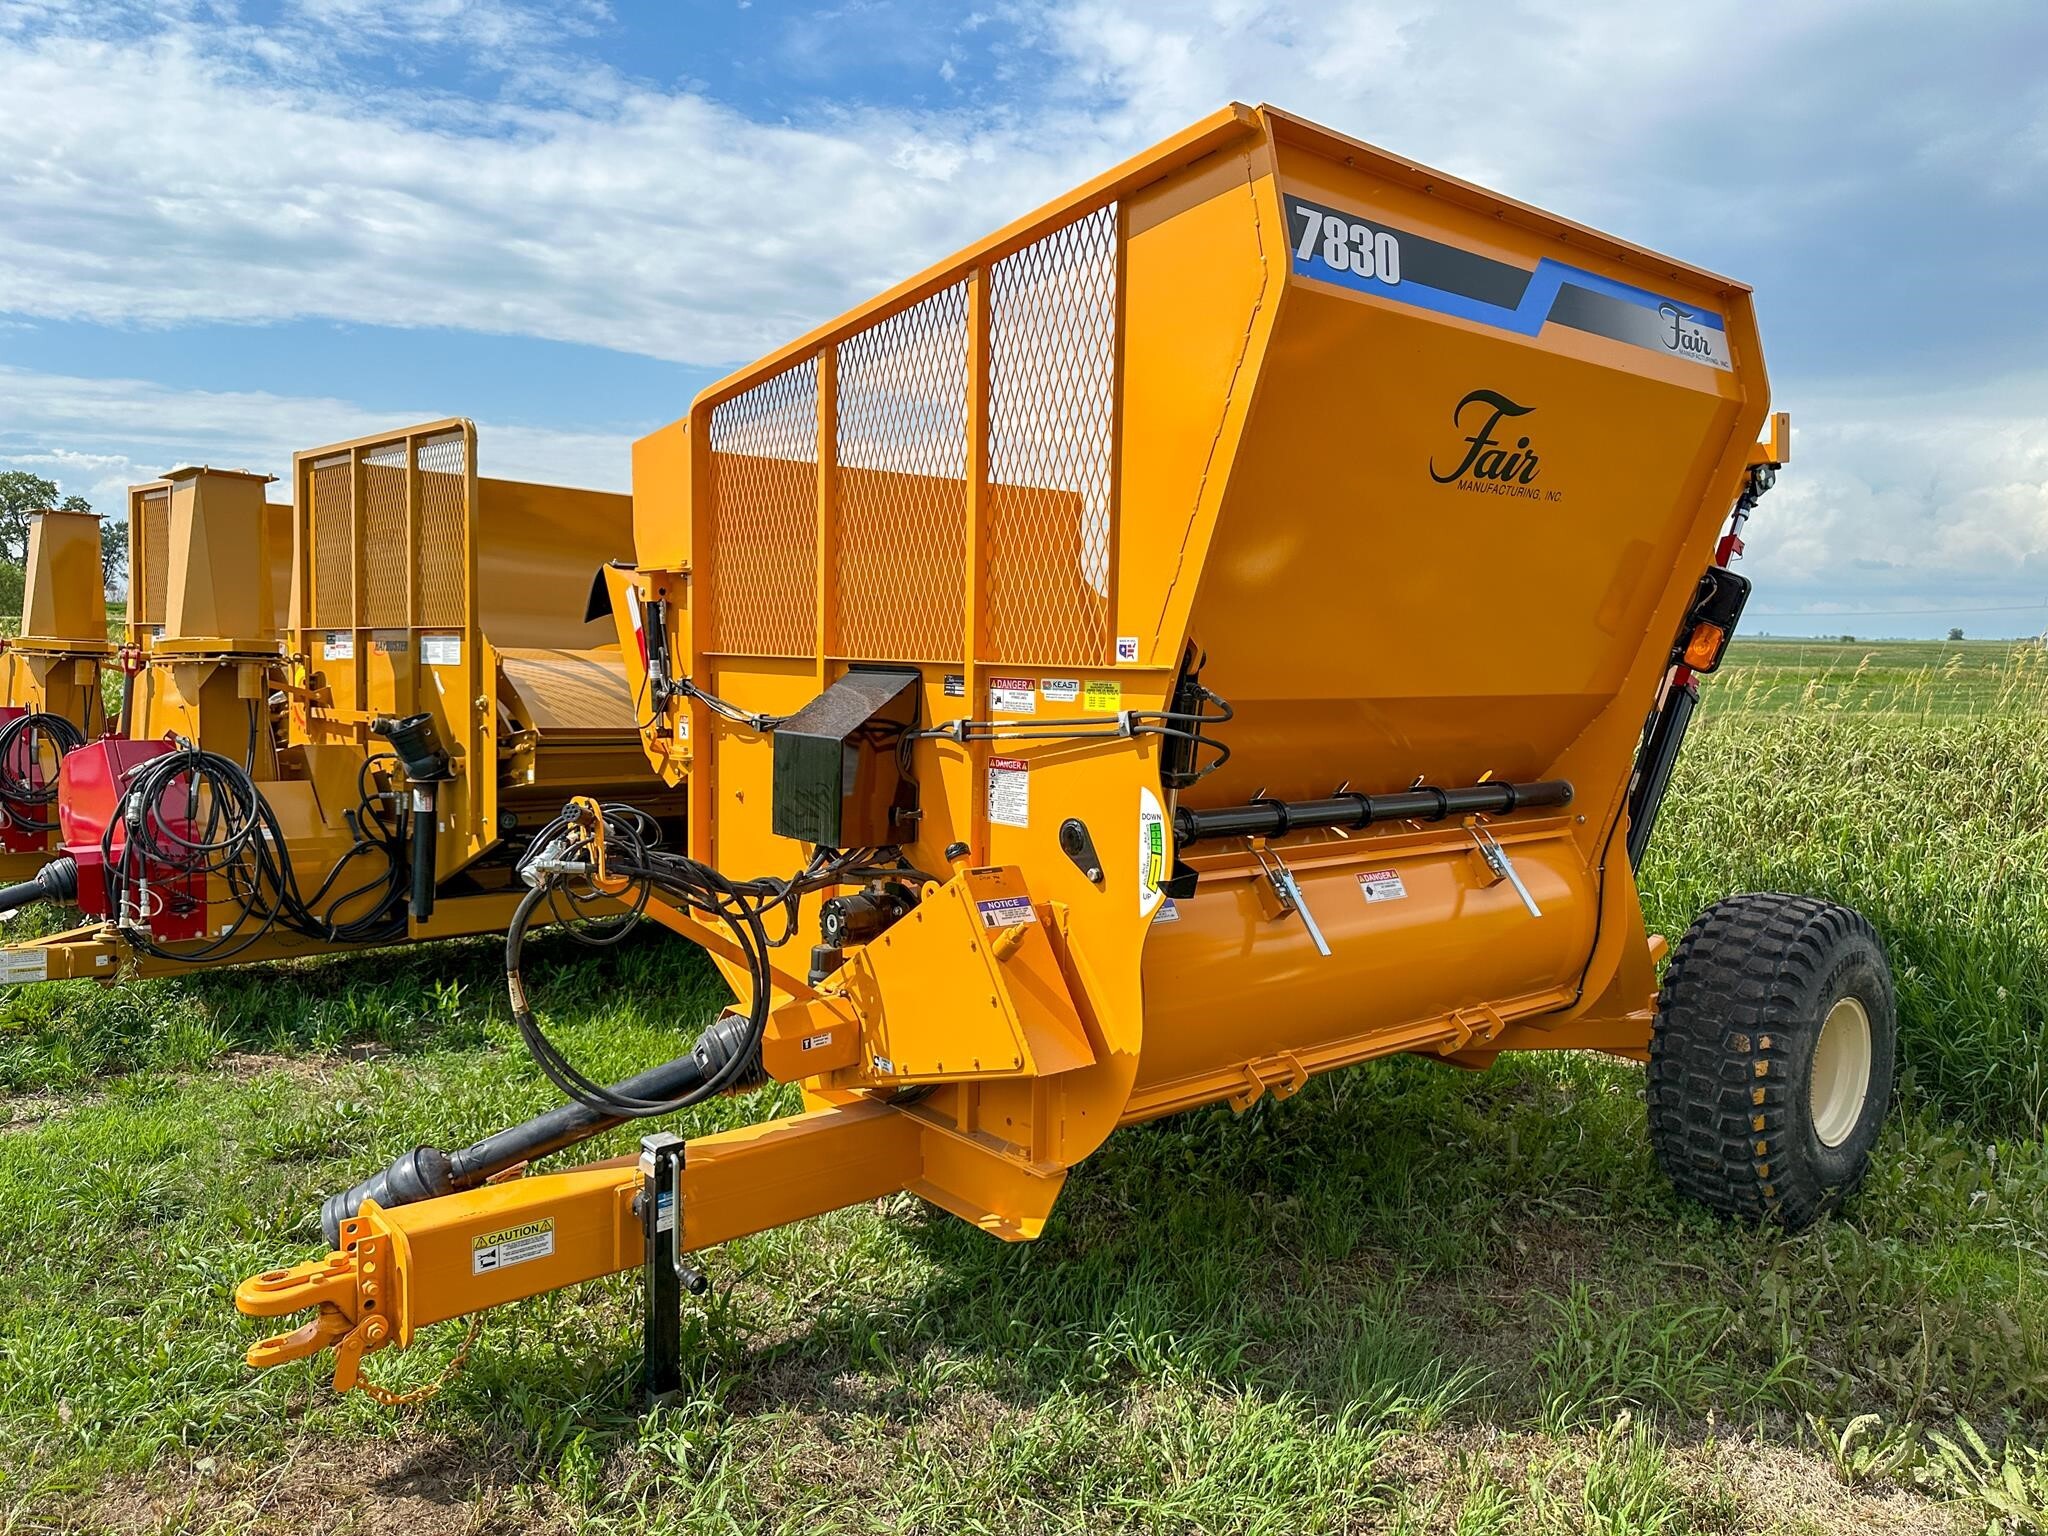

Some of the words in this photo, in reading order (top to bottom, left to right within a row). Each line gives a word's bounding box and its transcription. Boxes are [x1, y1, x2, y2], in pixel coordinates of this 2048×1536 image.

[1296, 205, 1400, 285] 7830
[1659, 302, 1712, 356] Fair
[1430, 389, 1541, 484] Fair
[1545, 491, 1562, 502] INC.
[997, 680, 1028, 690] DANGER
[1052, 681, 1078, 689] KEAST
[995, 760, 1022, 770] DANGER
[1142, 813, 1162, 821] DOWN
[1364, 871, 1392, 882] DANGER
[988, 899, 1020, 909] NOTICE
[488, 1224, 539, 1245] CAUTION
